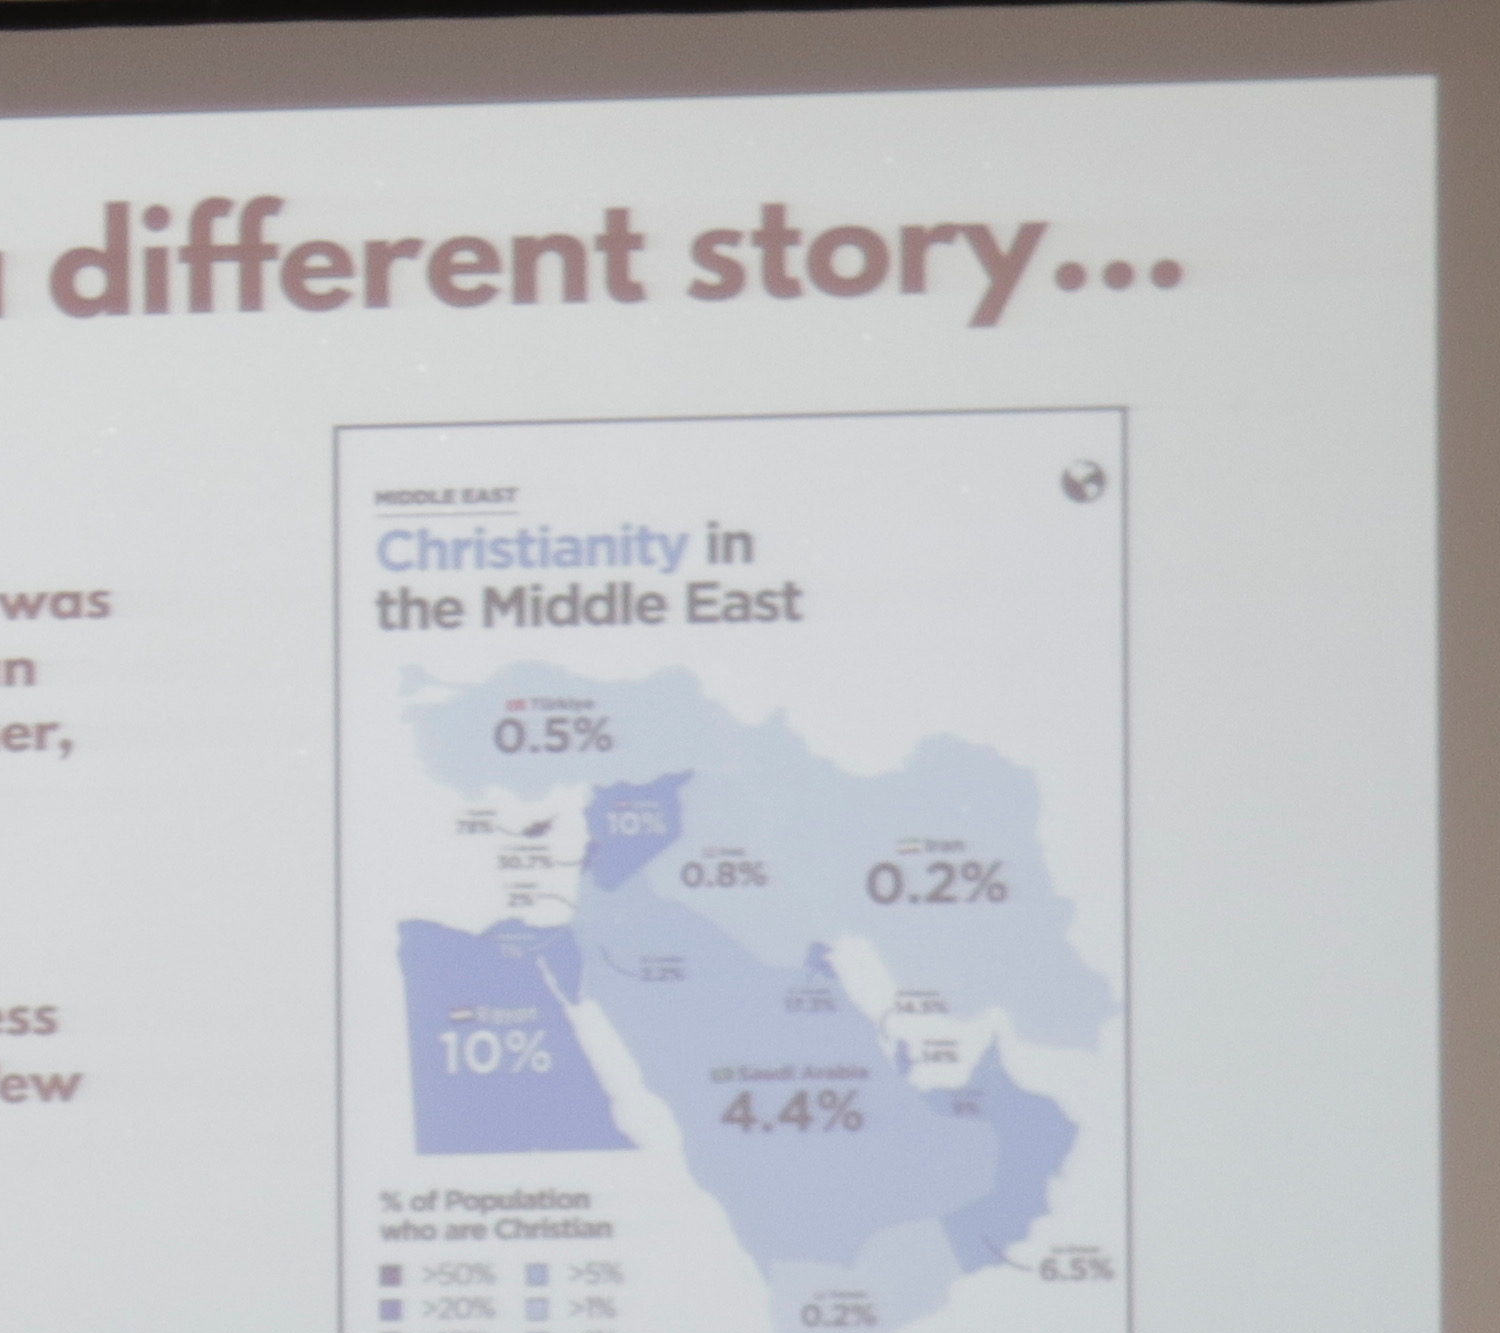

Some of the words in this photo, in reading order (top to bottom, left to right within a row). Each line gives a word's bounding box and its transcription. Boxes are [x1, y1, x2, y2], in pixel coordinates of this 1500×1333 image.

[49, 195, 647, 318] different
[688, 203, 1184, 328] story...
[375, 488, 456, 505] MIDDLE
[461, 487, 518, 504] EAST
[377, 524, 690, 574] Christianity
[707, 521, 754, 564] in
[375, 586, 465, 631] the
[483, 581, 668, 628] Middle
[686, 581, 803, 624] East
[493, 716, 614, 754] 0.5%
[606, 812, 666, 835] 10%
[680, 861, 768, 888] 0.8%
[866, 861, 1008, 905] 0.2%
[439, 1030, 551, 1074] 10%
[721, 1089, 864, 1132] 4.4%
[409, 1190, 439, 1212] of
[445, 1189, 591, 1215] Population
[381, 1220, 437, 1241] who
[445, 1223, 487, 1240] are
[493, 1218, 613, 1240] Christian
[1039, 1257, 1114, 1281] 6.5%
[801, 1303, 877, 1327] 0.2%
